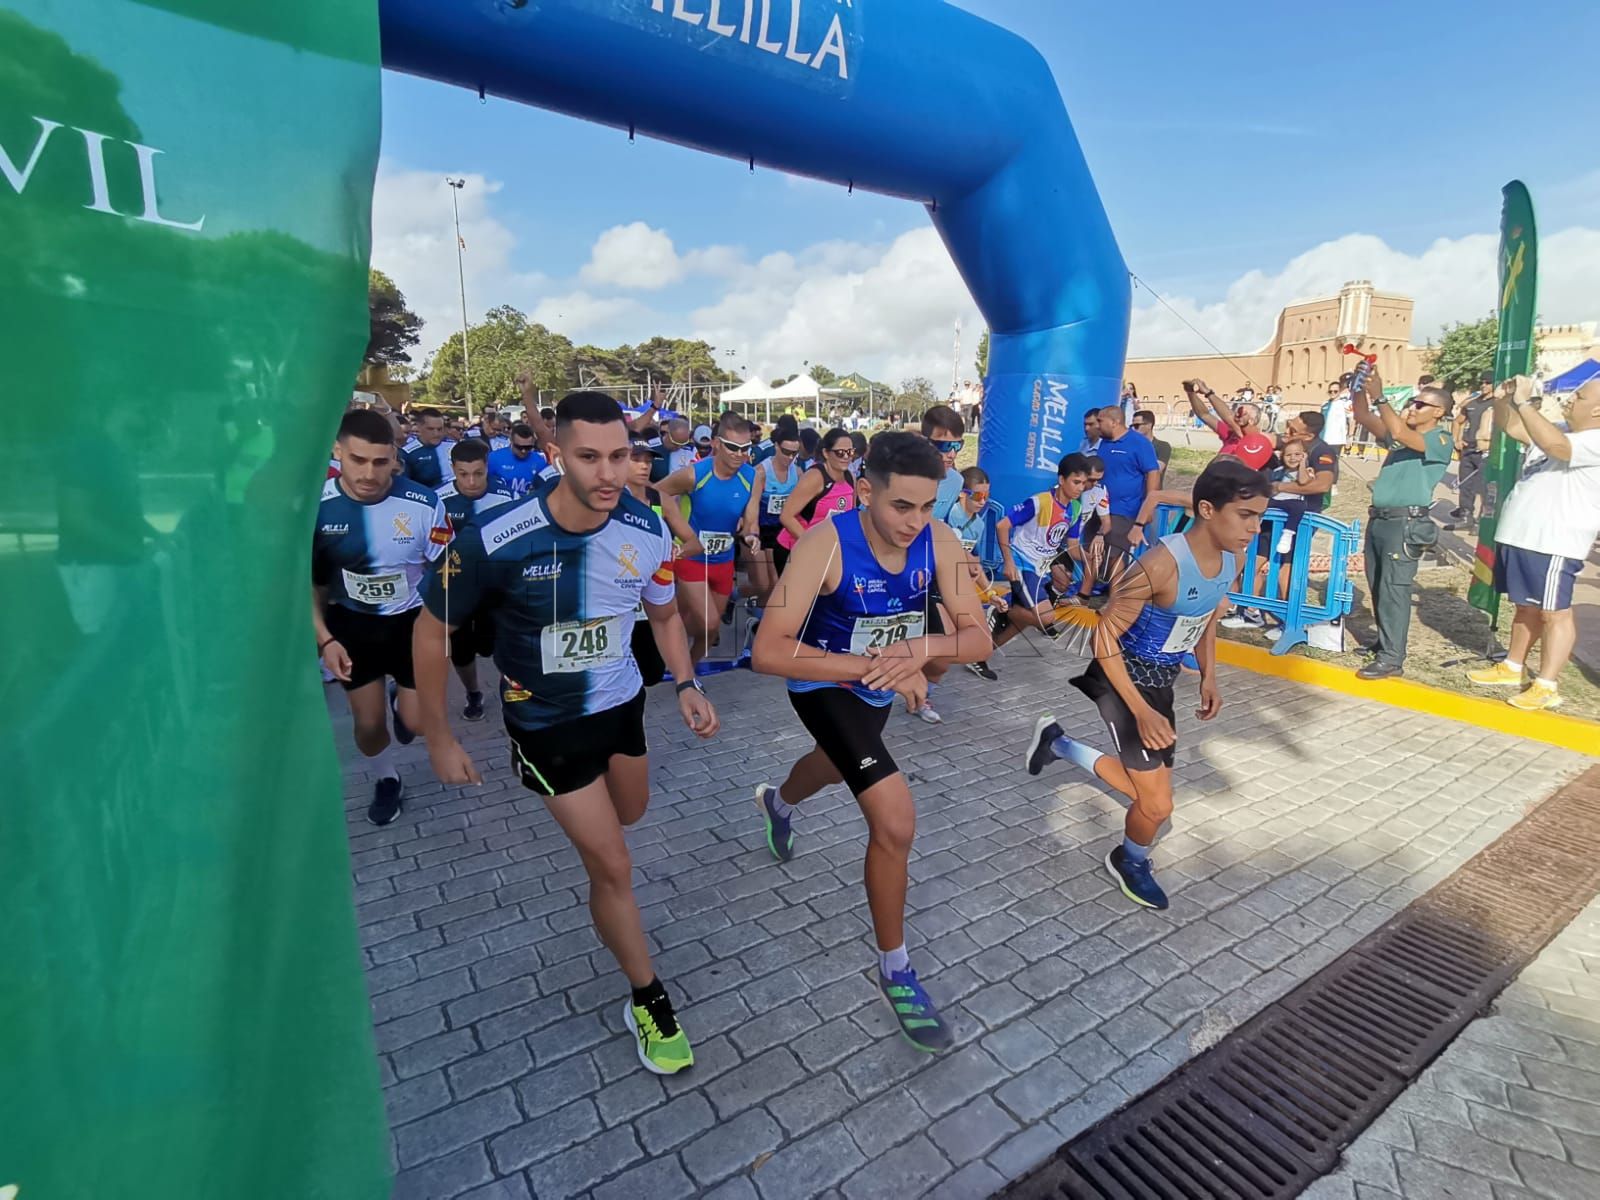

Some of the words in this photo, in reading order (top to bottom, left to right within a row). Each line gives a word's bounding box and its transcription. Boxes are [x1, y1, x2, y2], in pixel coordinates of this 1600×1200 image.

[650, 0, 849, 80] LILLA
[1036, 380, 1069, 473] MELILLA
[405, 490, 429, 503] CIVIL
[492, 515, 542, 545] GUARDIA
[623, 512, 652, 530] CIVIL
[706, 537, 726, 551] 381
[521, 561, 564, 578] MELILLA
[356, 581, 396, 597] 259
[561, 625, 609, 658] 248
[868, 624, 908, 648] 219
